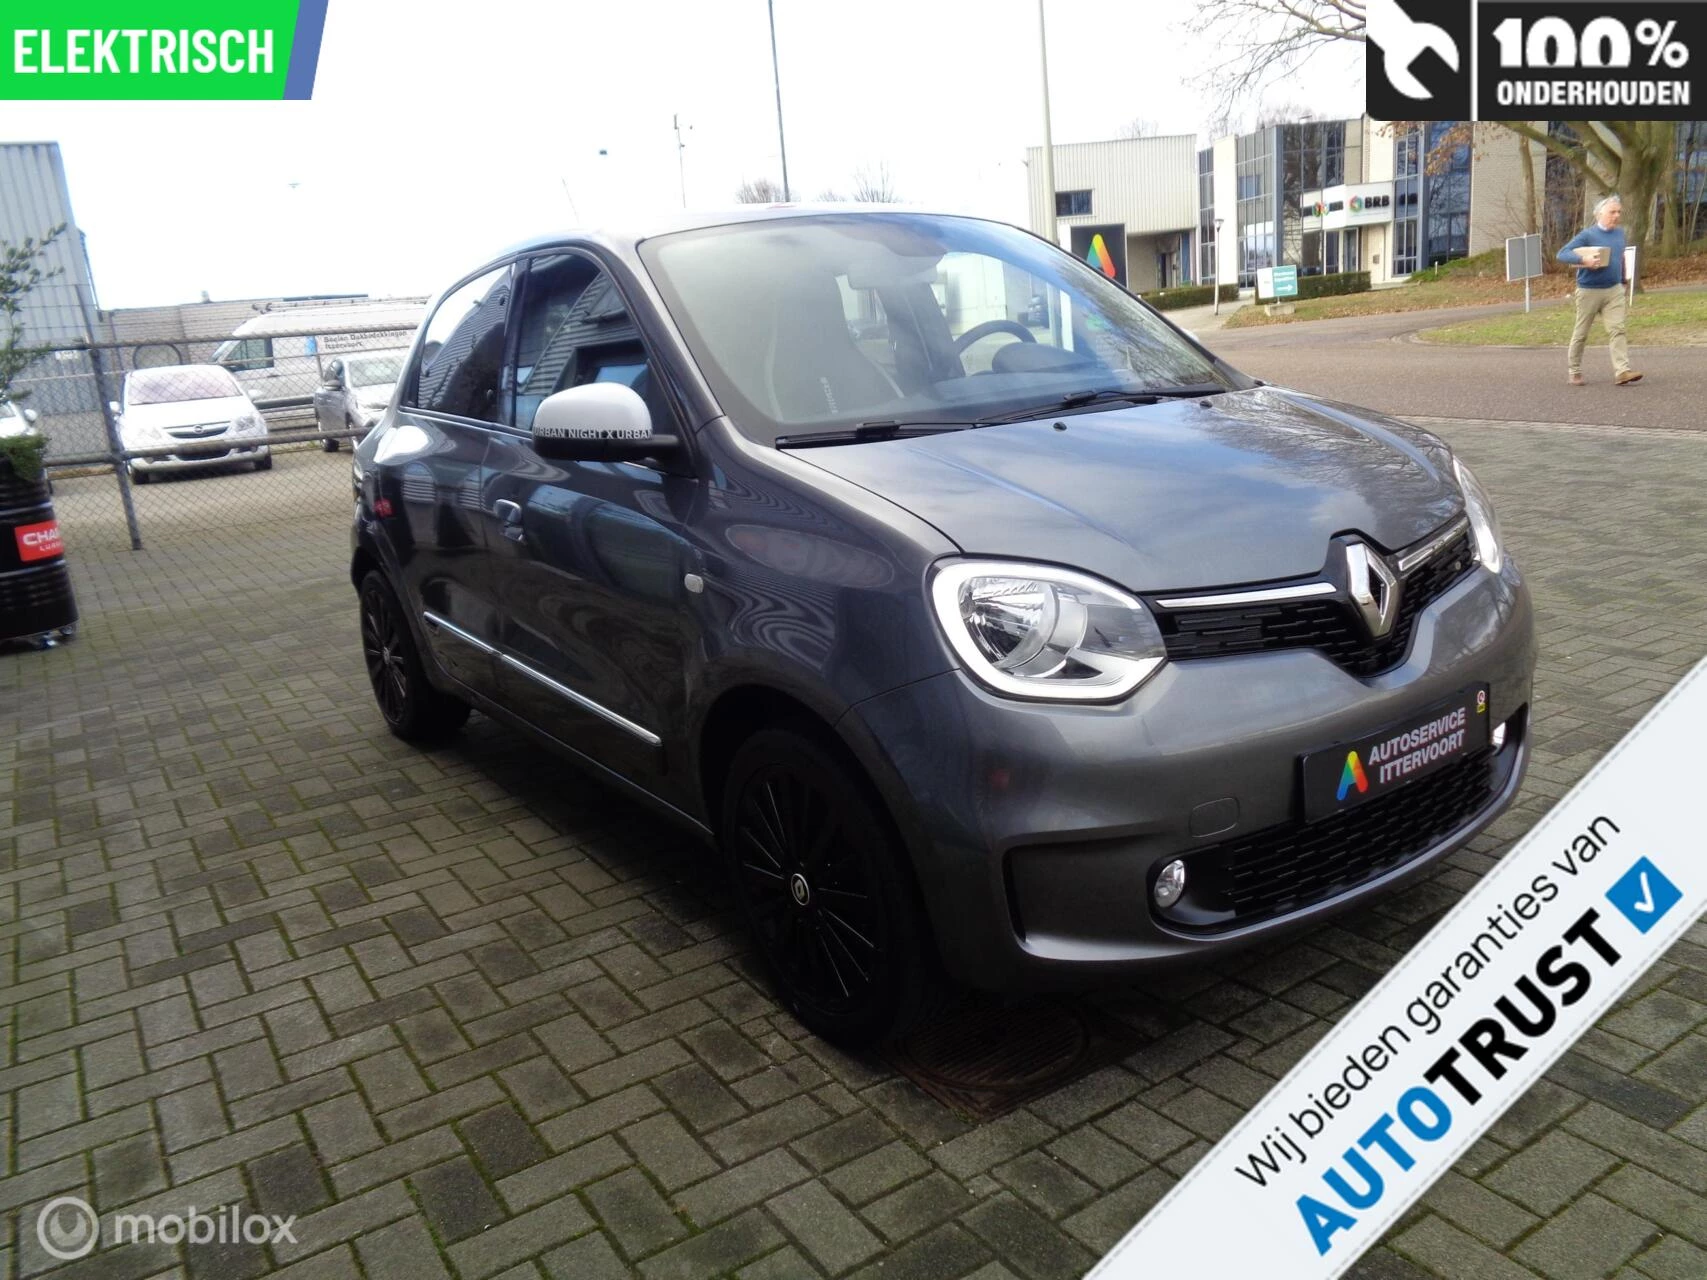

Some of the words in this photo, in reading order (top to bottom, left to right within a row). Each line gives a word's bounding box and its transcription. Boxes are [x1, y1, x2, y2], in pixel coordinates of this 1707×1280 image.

[1365, 195, 1390, 209] BRB
[568, 428, 603, 440] NIGHT
[607, 429, 615, 440] X
[1368, 706, 1467, 766] AUTOSERVICE
[1379, 728, 1466, 785] ITTERVOORT
